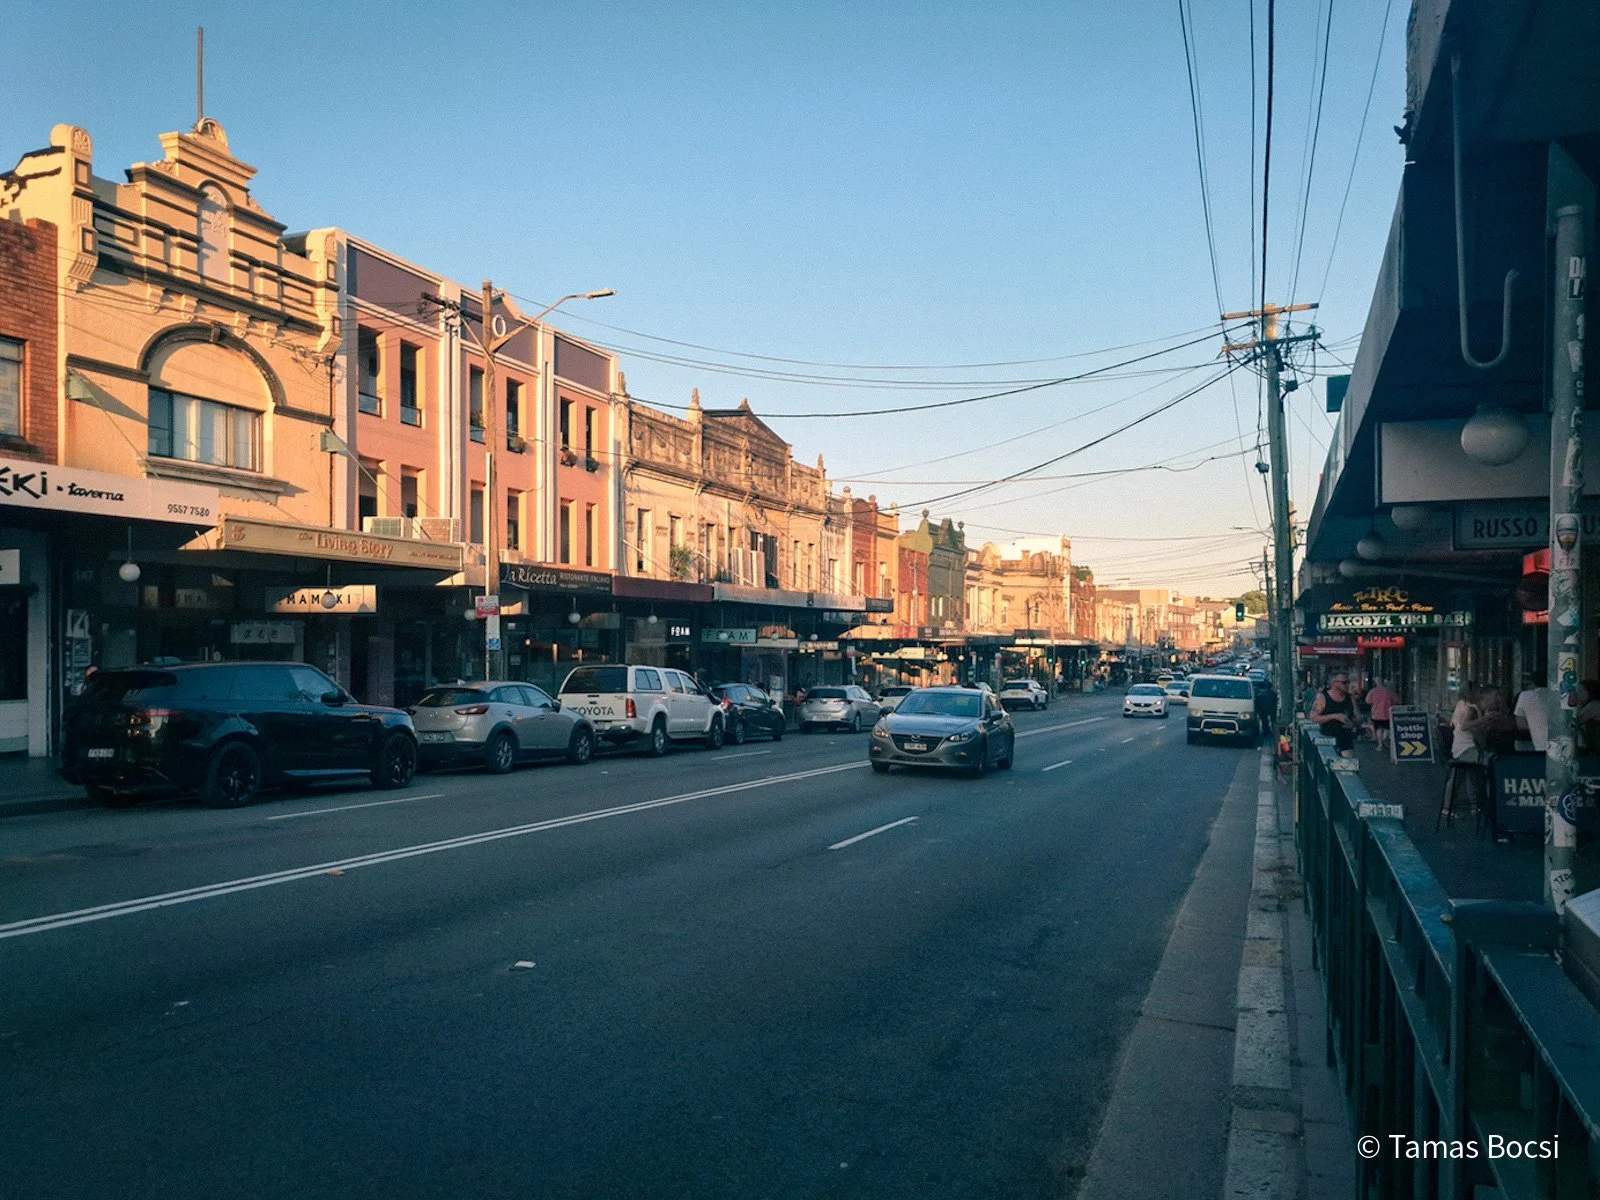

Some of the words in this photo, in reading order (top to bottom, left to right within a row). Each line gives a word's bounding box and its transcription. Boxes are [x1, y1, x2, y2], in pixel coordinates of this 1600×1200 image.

[68, 482, 125, 501] taverna
[168, 504, 187, 515] 9557
[190, 506, 210, 517] 7580
[1473, 517, 1539, 538] RUSSO
[316, 532, 357, 556] Living
[361, 539, 394, 560] Story
[518, 566, 557, 585] Ricetta
[1328, 615, 1392, 627] JACOBY'S
[1399, 614, 1428, 624] TIKI
[1433, 613, 1465, 625] BAR
[671, 626, 690, 636] FOAM
[1401, 732, 1423, 740] shop
